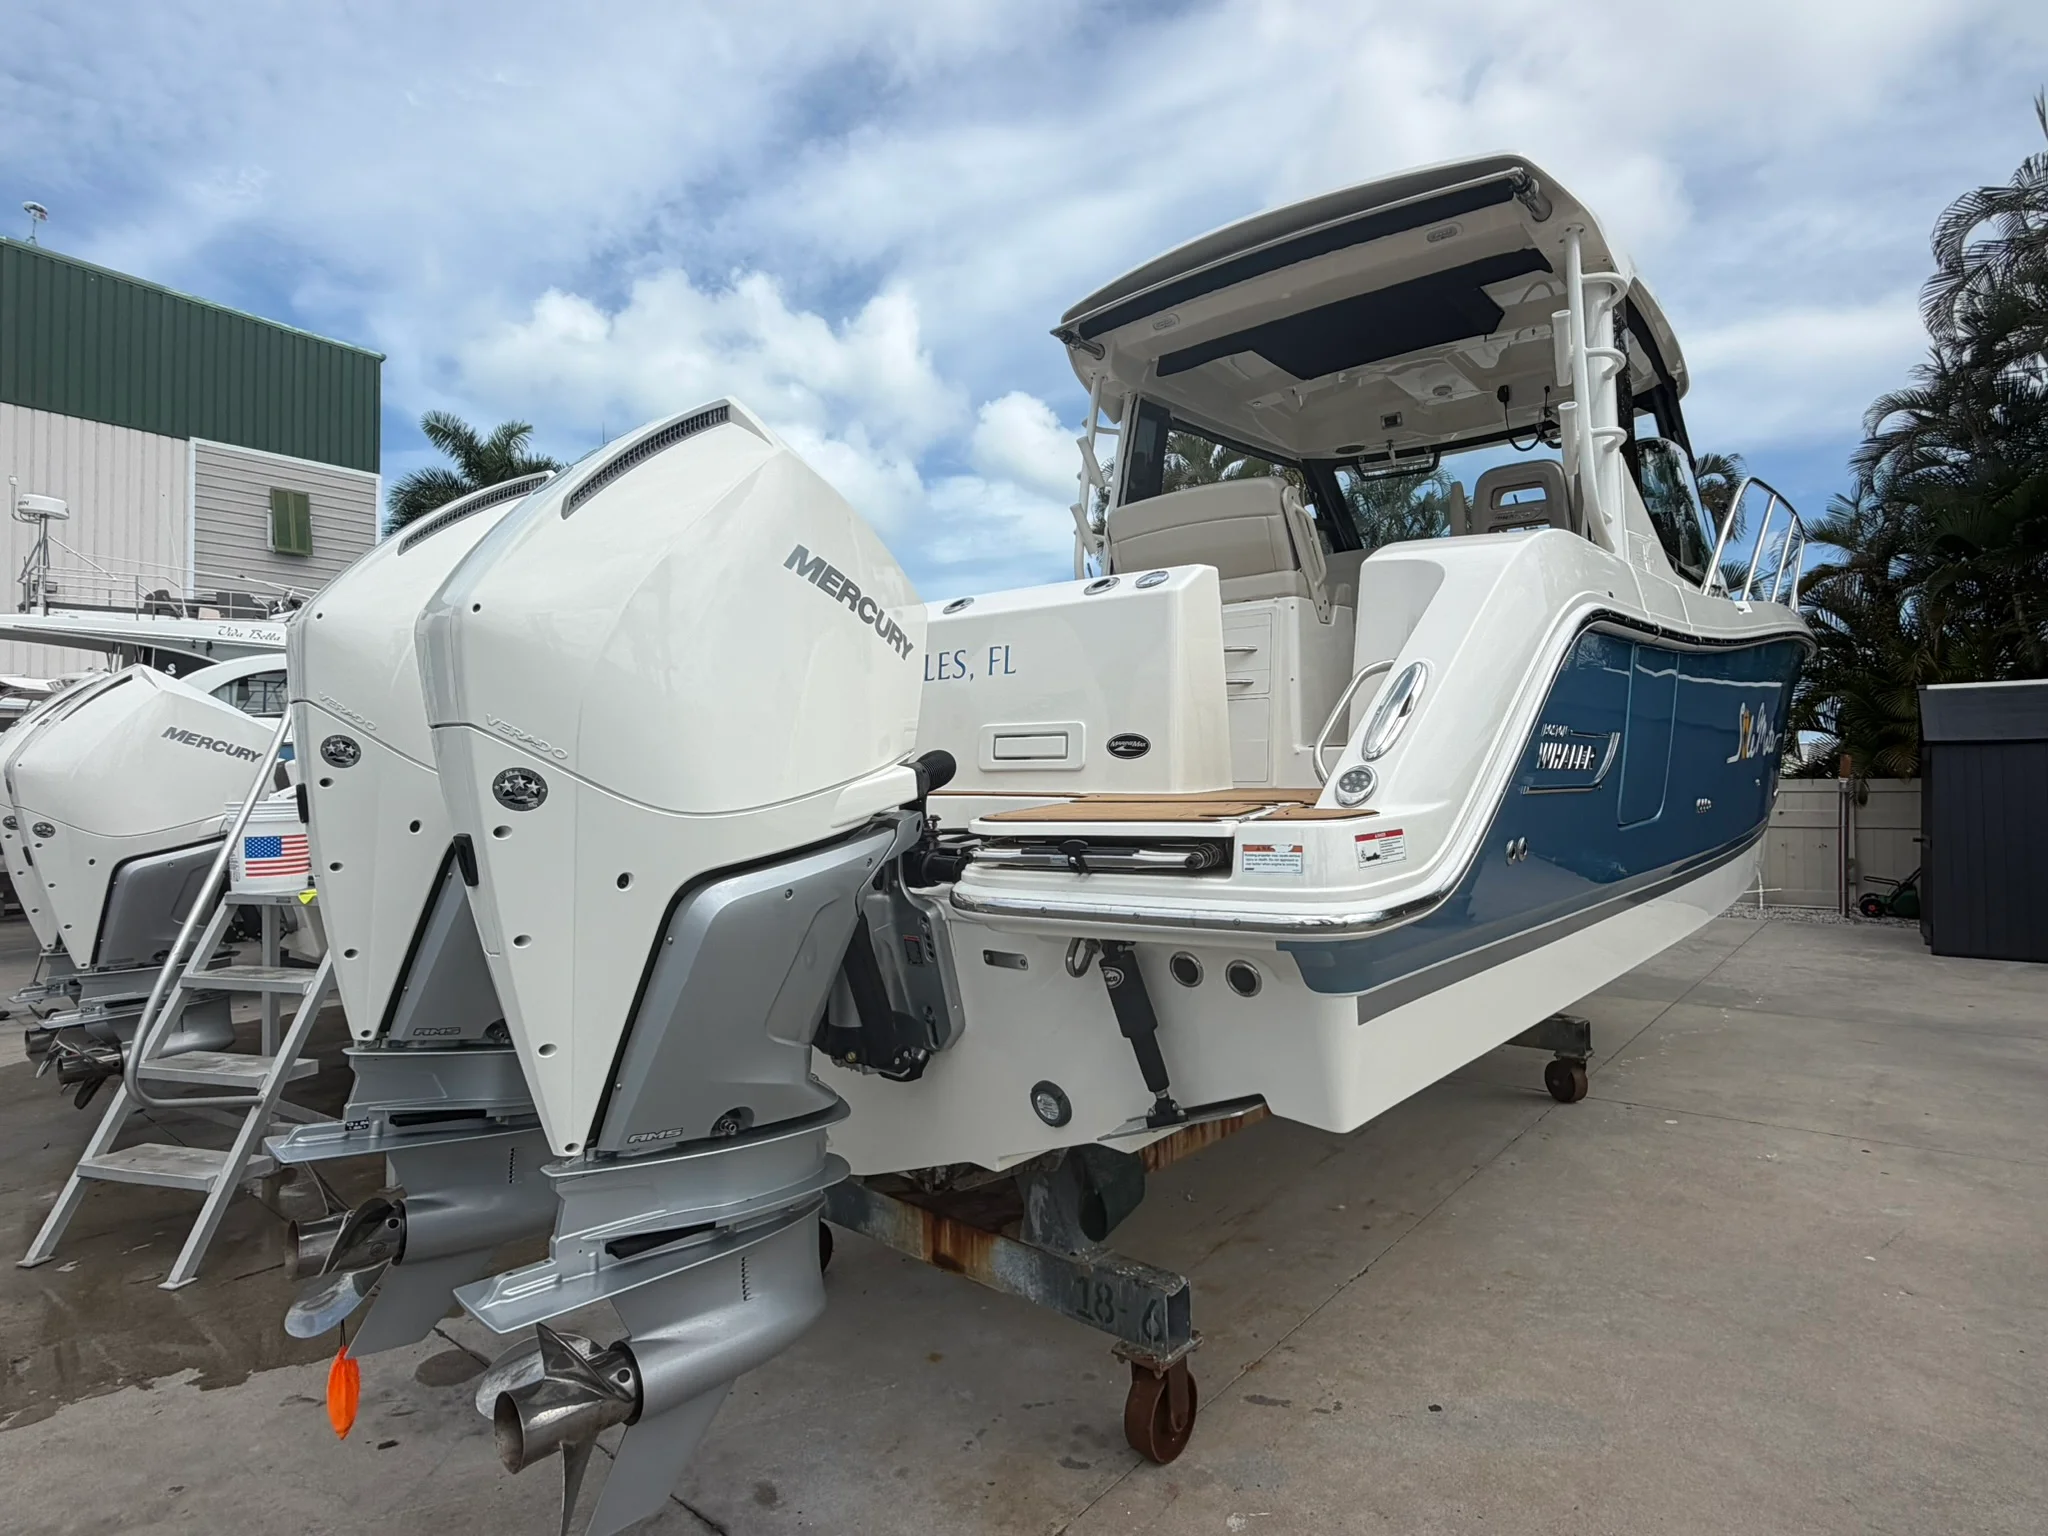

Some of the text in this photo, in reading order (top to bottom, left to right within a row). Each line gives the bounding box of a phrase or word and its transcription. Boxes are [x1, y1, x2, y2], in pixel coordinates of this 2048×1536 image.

[783, 544, 914, 660] MERCURY
[218, 625, 281, 641] Vida Bella
[988, 645, 1017, 676] FL
[161, 727, 263, 763] MERCURY
[486, 713, 568, 760] VERADO
[627, 1128, 683, 1144] AMS
